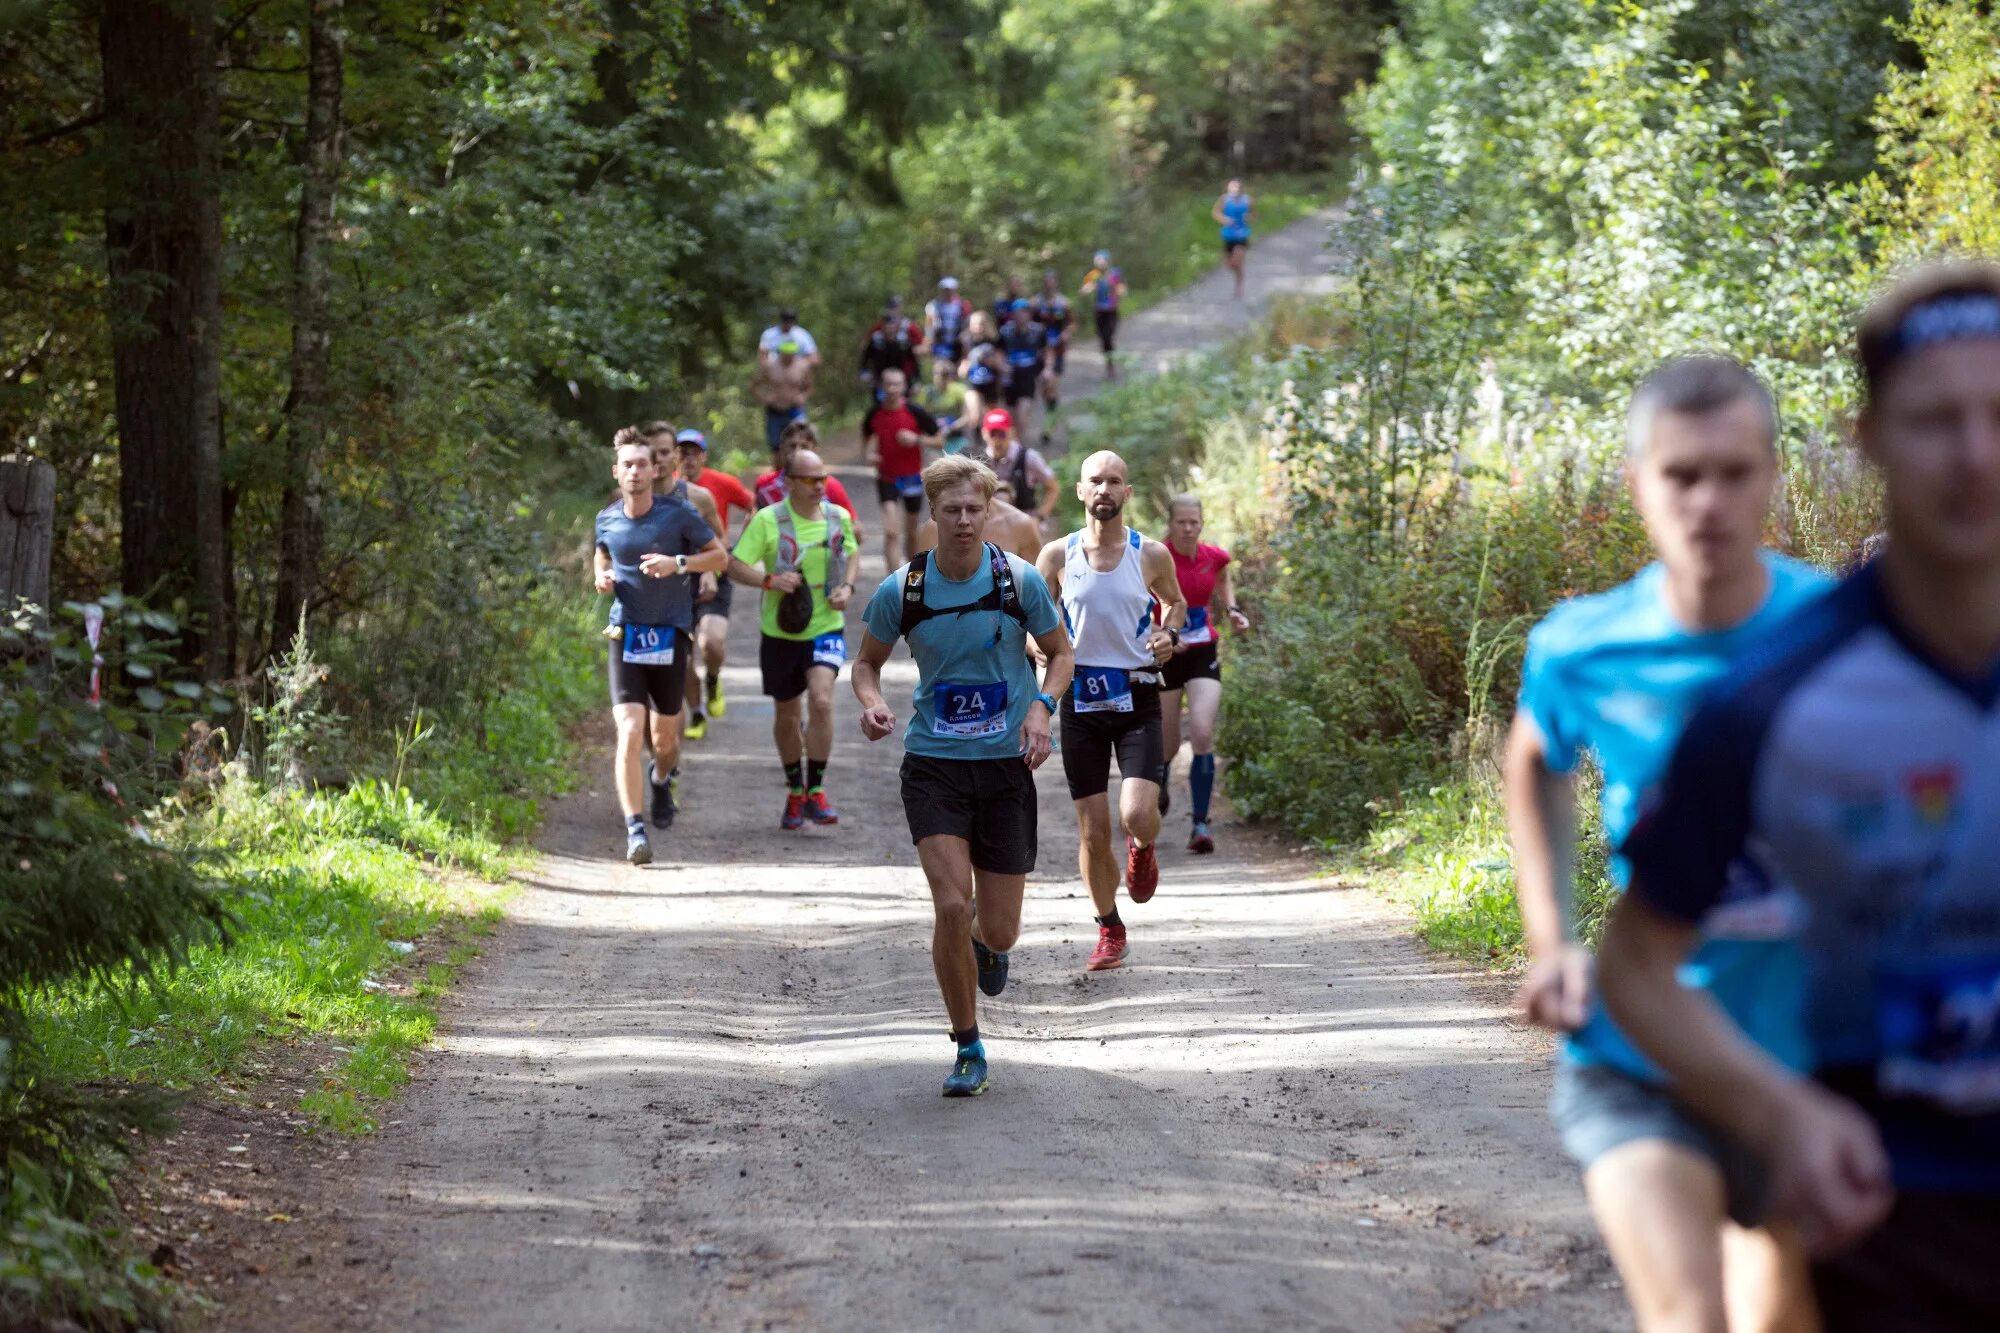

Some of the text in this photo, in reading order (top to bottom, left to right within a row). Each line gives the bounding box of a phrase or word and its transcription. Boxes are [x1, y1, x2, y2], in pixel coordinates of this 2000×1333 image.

[637, 631, 659, 648] 10
[1087, 673, 1109, 695] 81
[953, 691, 986, 714] 24
